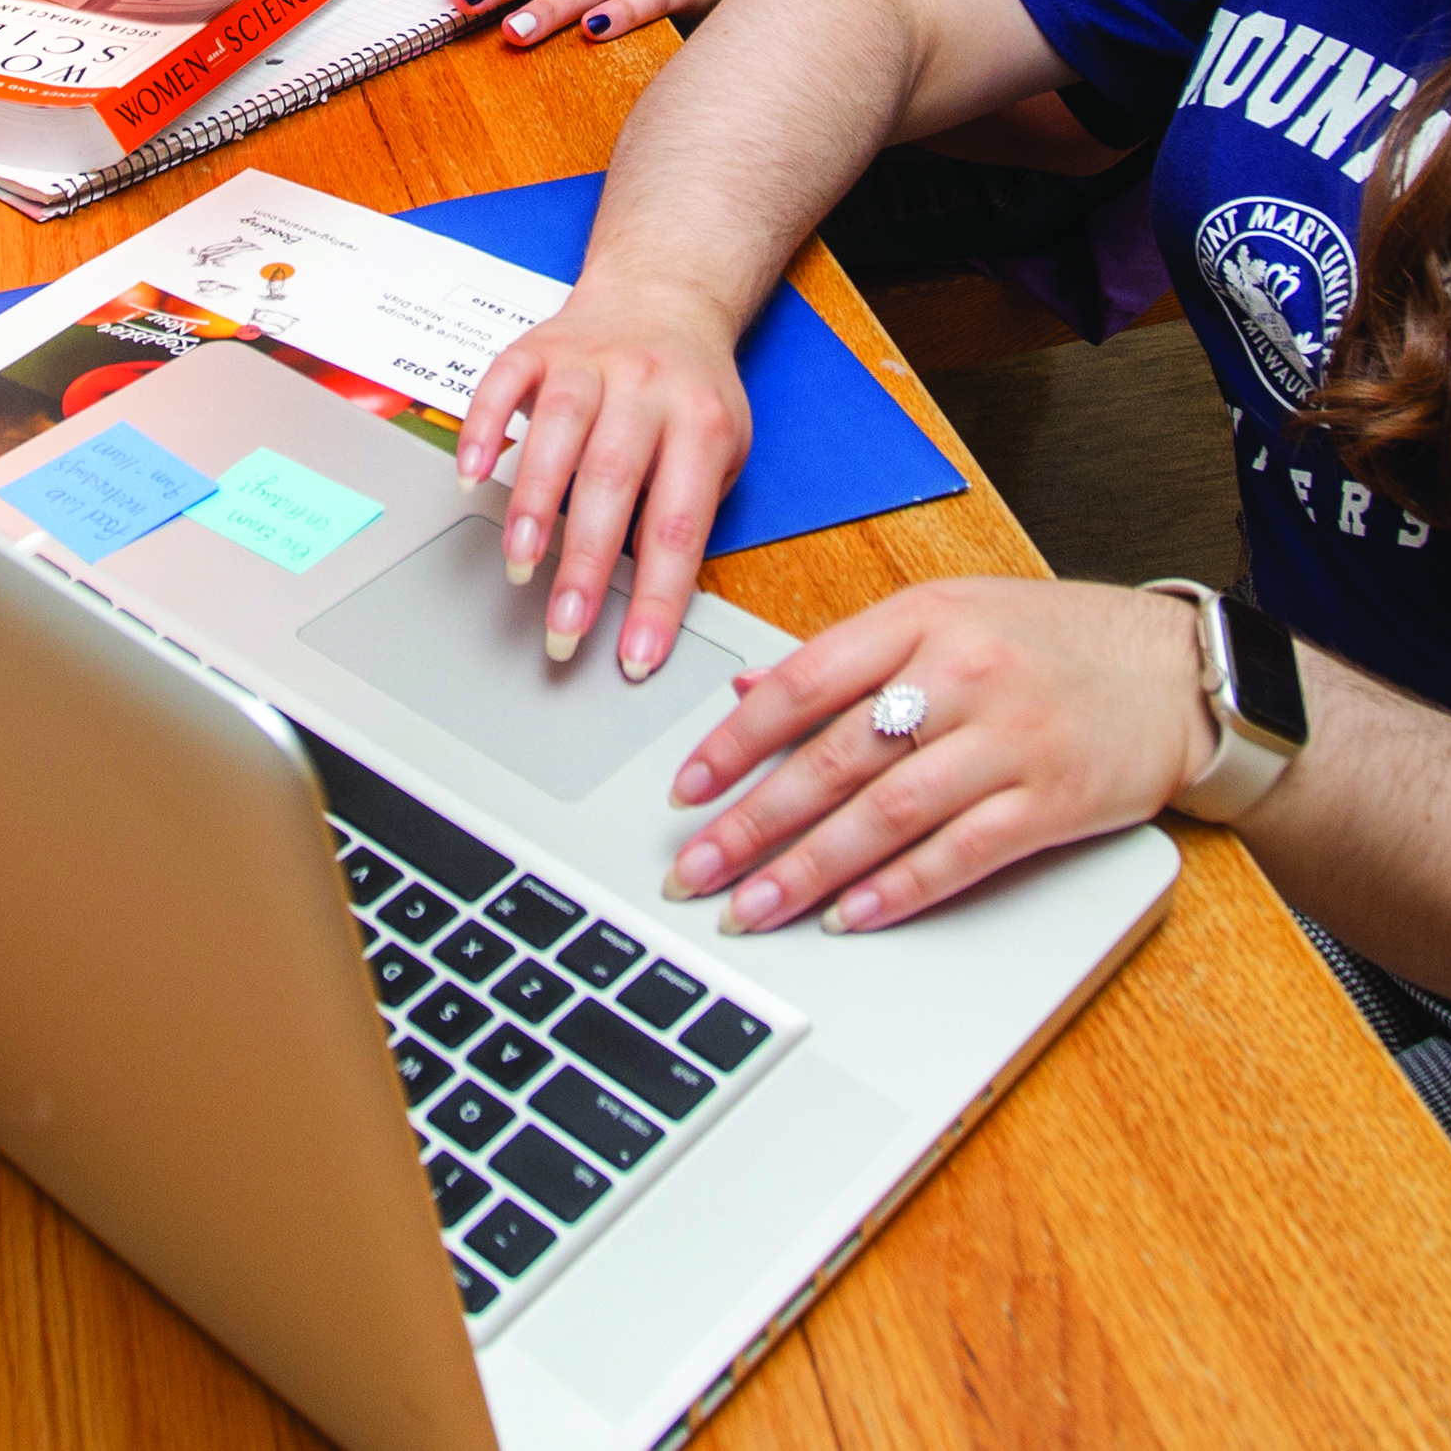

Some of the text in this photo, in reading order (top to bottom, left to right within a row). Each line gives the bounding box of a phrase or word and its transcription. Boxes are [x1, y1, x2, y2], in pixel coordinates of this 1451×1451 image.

[27, 10, 92, 27] IMPACT
[108, 23, 162, 38] SOCIAL
[8, 84, 35, 94] AND
[114, 50, 210, 128] WOMEN
[206, 37, 227, 63] and
[240, 217, 302, 245] Booking
[253, 209, 359, 252] reallygreatsite.com
[1247, 204, 1330, 254] MARY
[377, 304, 422, 327] Recipe
[383, 292, 492, 341] Curry Miso Dish
[471, 297, 506, 316] Sato
[145, 313, 197, 336] Now
[424, 323, 435, 332] &
[96, 322, 198, 356] Register
[436, 329, 486, 352] culture
[392, 357, 438, 381] 2023
[445, 360, 478, 377] PM
[351, 865, 370, 883] V
[522, 878, 577, 917] command
[406, 900, 426, 919] C
[461, 937, 484, 960] X
[599, 927, 636, 955] option
[382, 961, 403, 982] D
[653, 964, 697, 995] control
[520, 978, 543, 999] Z
[439, 1002, 460, 1022] S
[501, 1042, 522, 1063] A
[398, 1055, 424, 1081] W
[459, 1099, 482, 1123] Q
